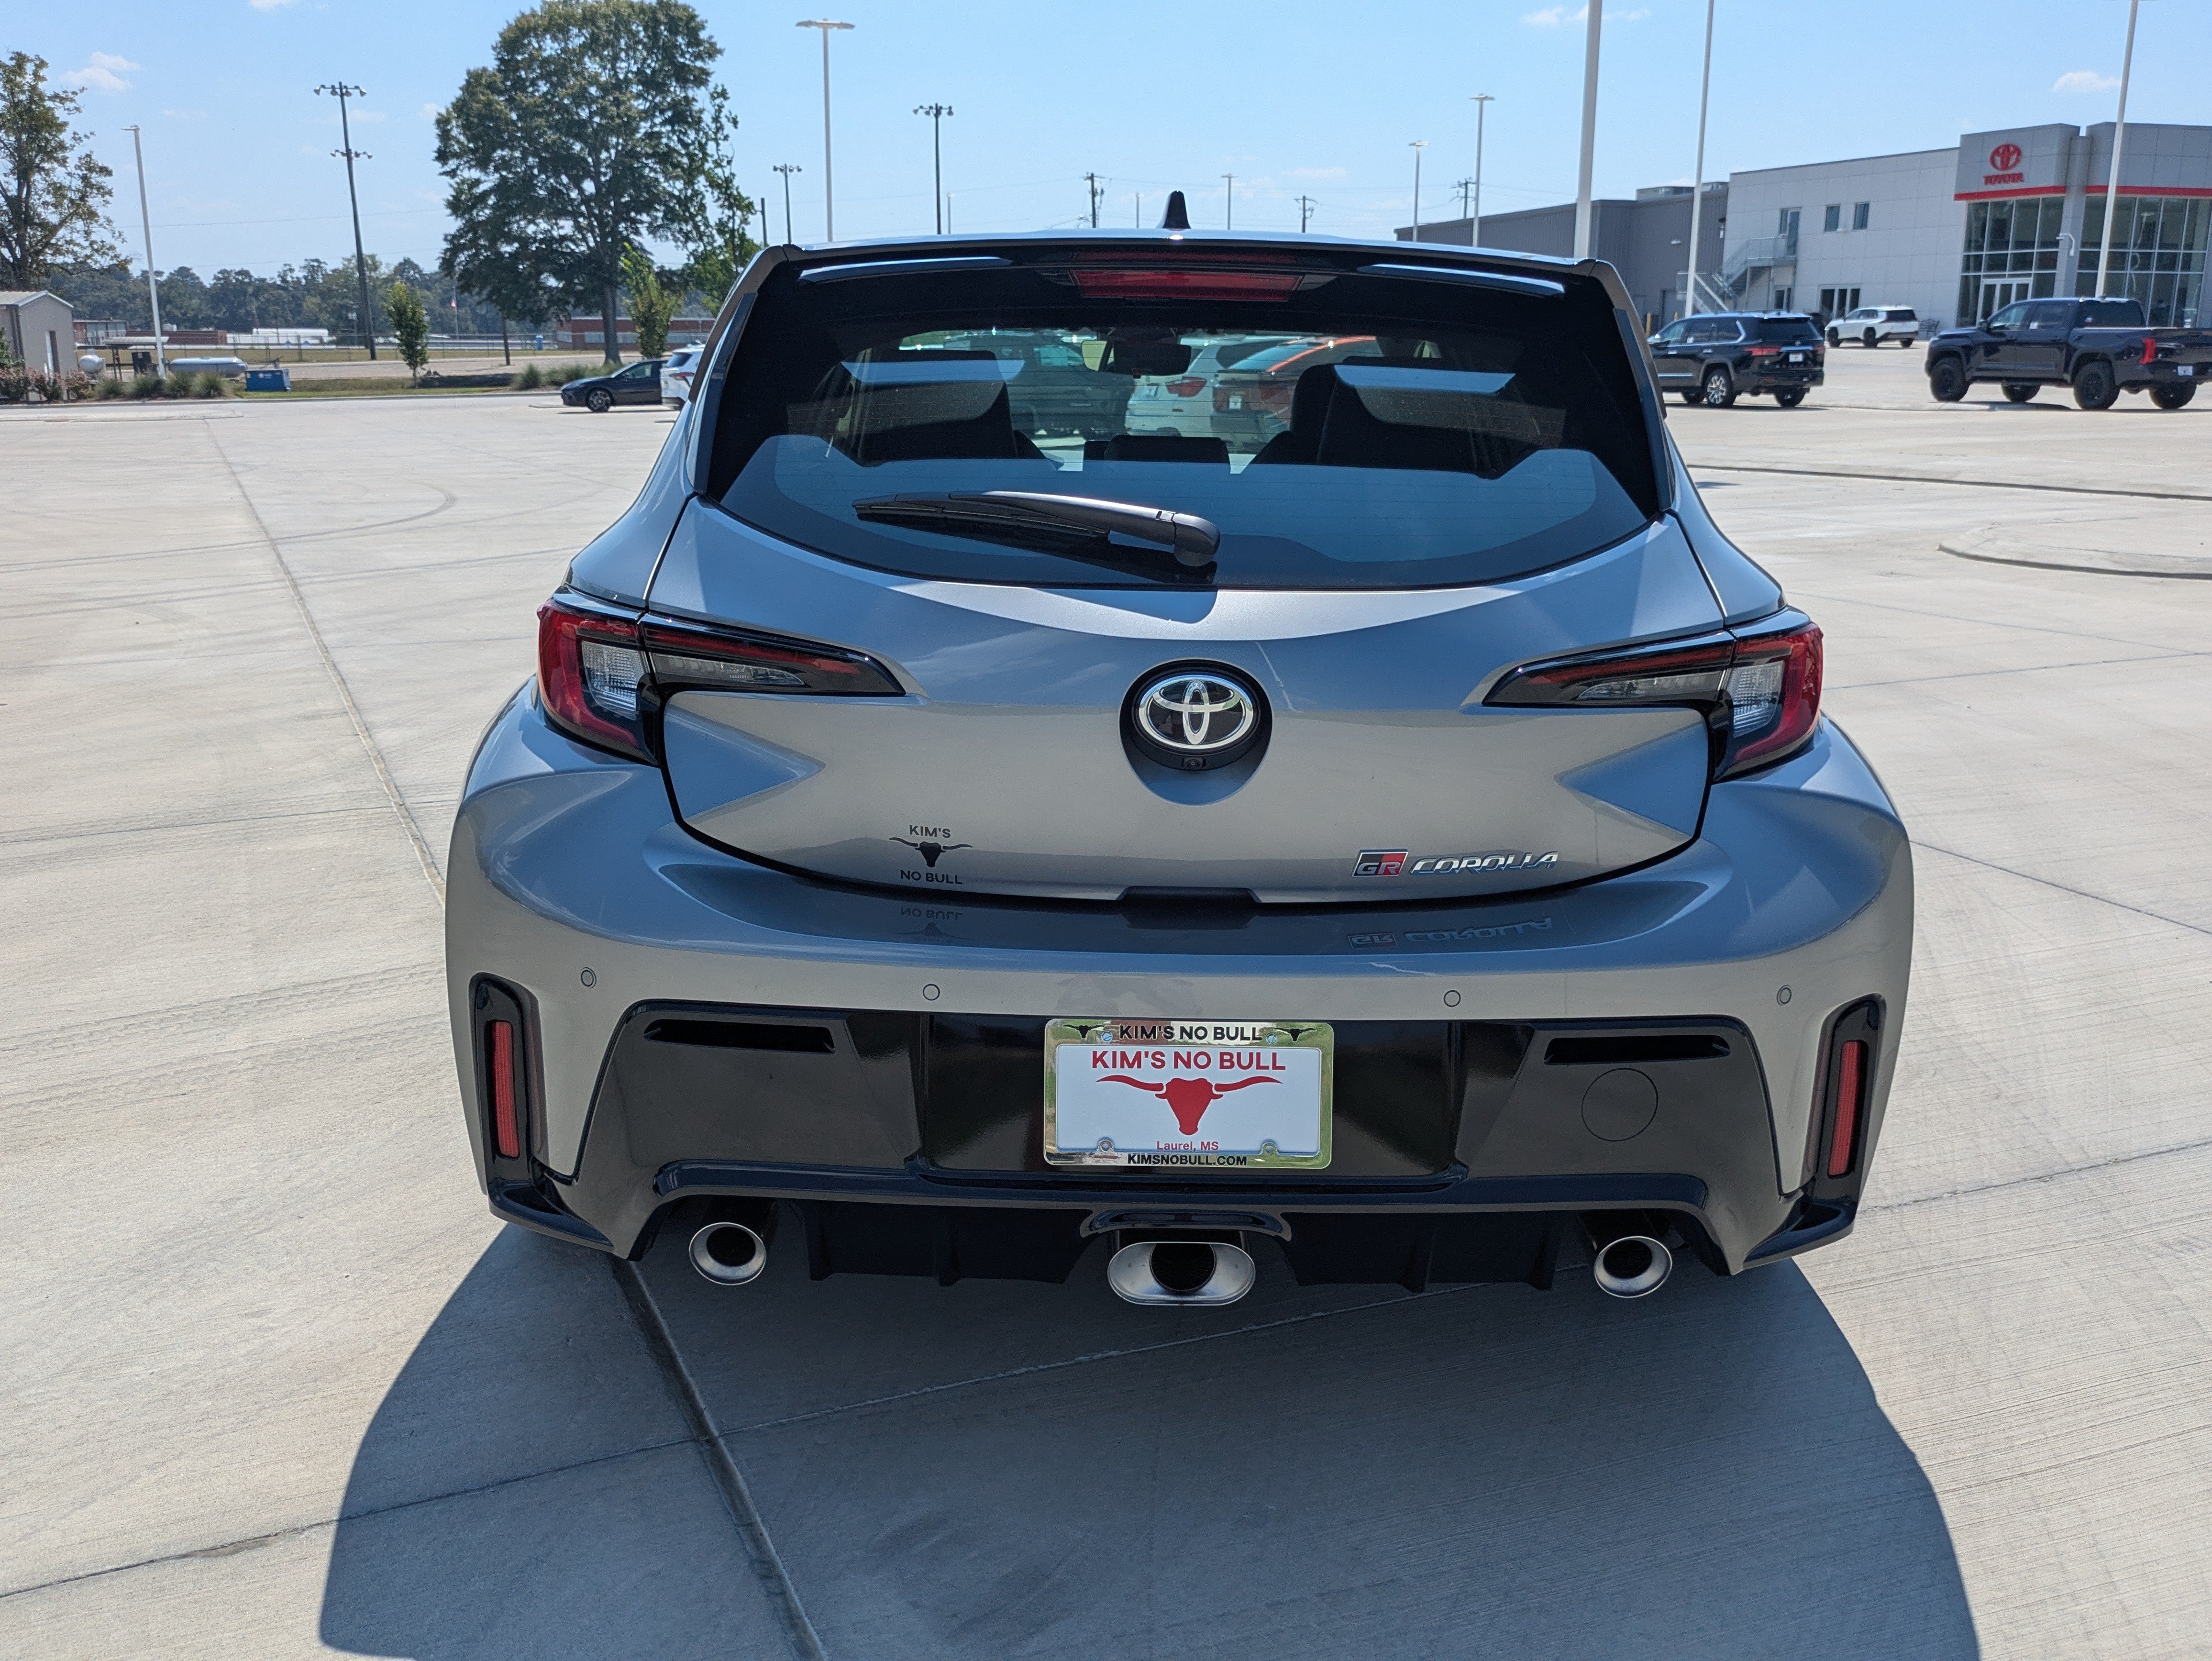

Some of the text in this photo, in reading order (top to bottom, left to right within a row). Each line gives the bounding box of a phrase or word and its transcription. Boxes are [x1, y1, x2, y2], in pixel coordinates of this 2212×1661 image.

[1983, 173, 2024, 185] TOYOTA
[909, 825, 951, 838] KIM'S
[1356, 852, 1558, 875] GR COROLLA
[900, 870, 962, 885] NO BULL
[1119, 1025, 1262, 1041] KIM'S NO BULL
[1092, 1051, 1286, 1070] KIM'S NO BULL
[1157, 1141, 1219, 1152] Laurel, MS
[1128, 1154, 1247, 1166] KIMSNOBULL.COM
